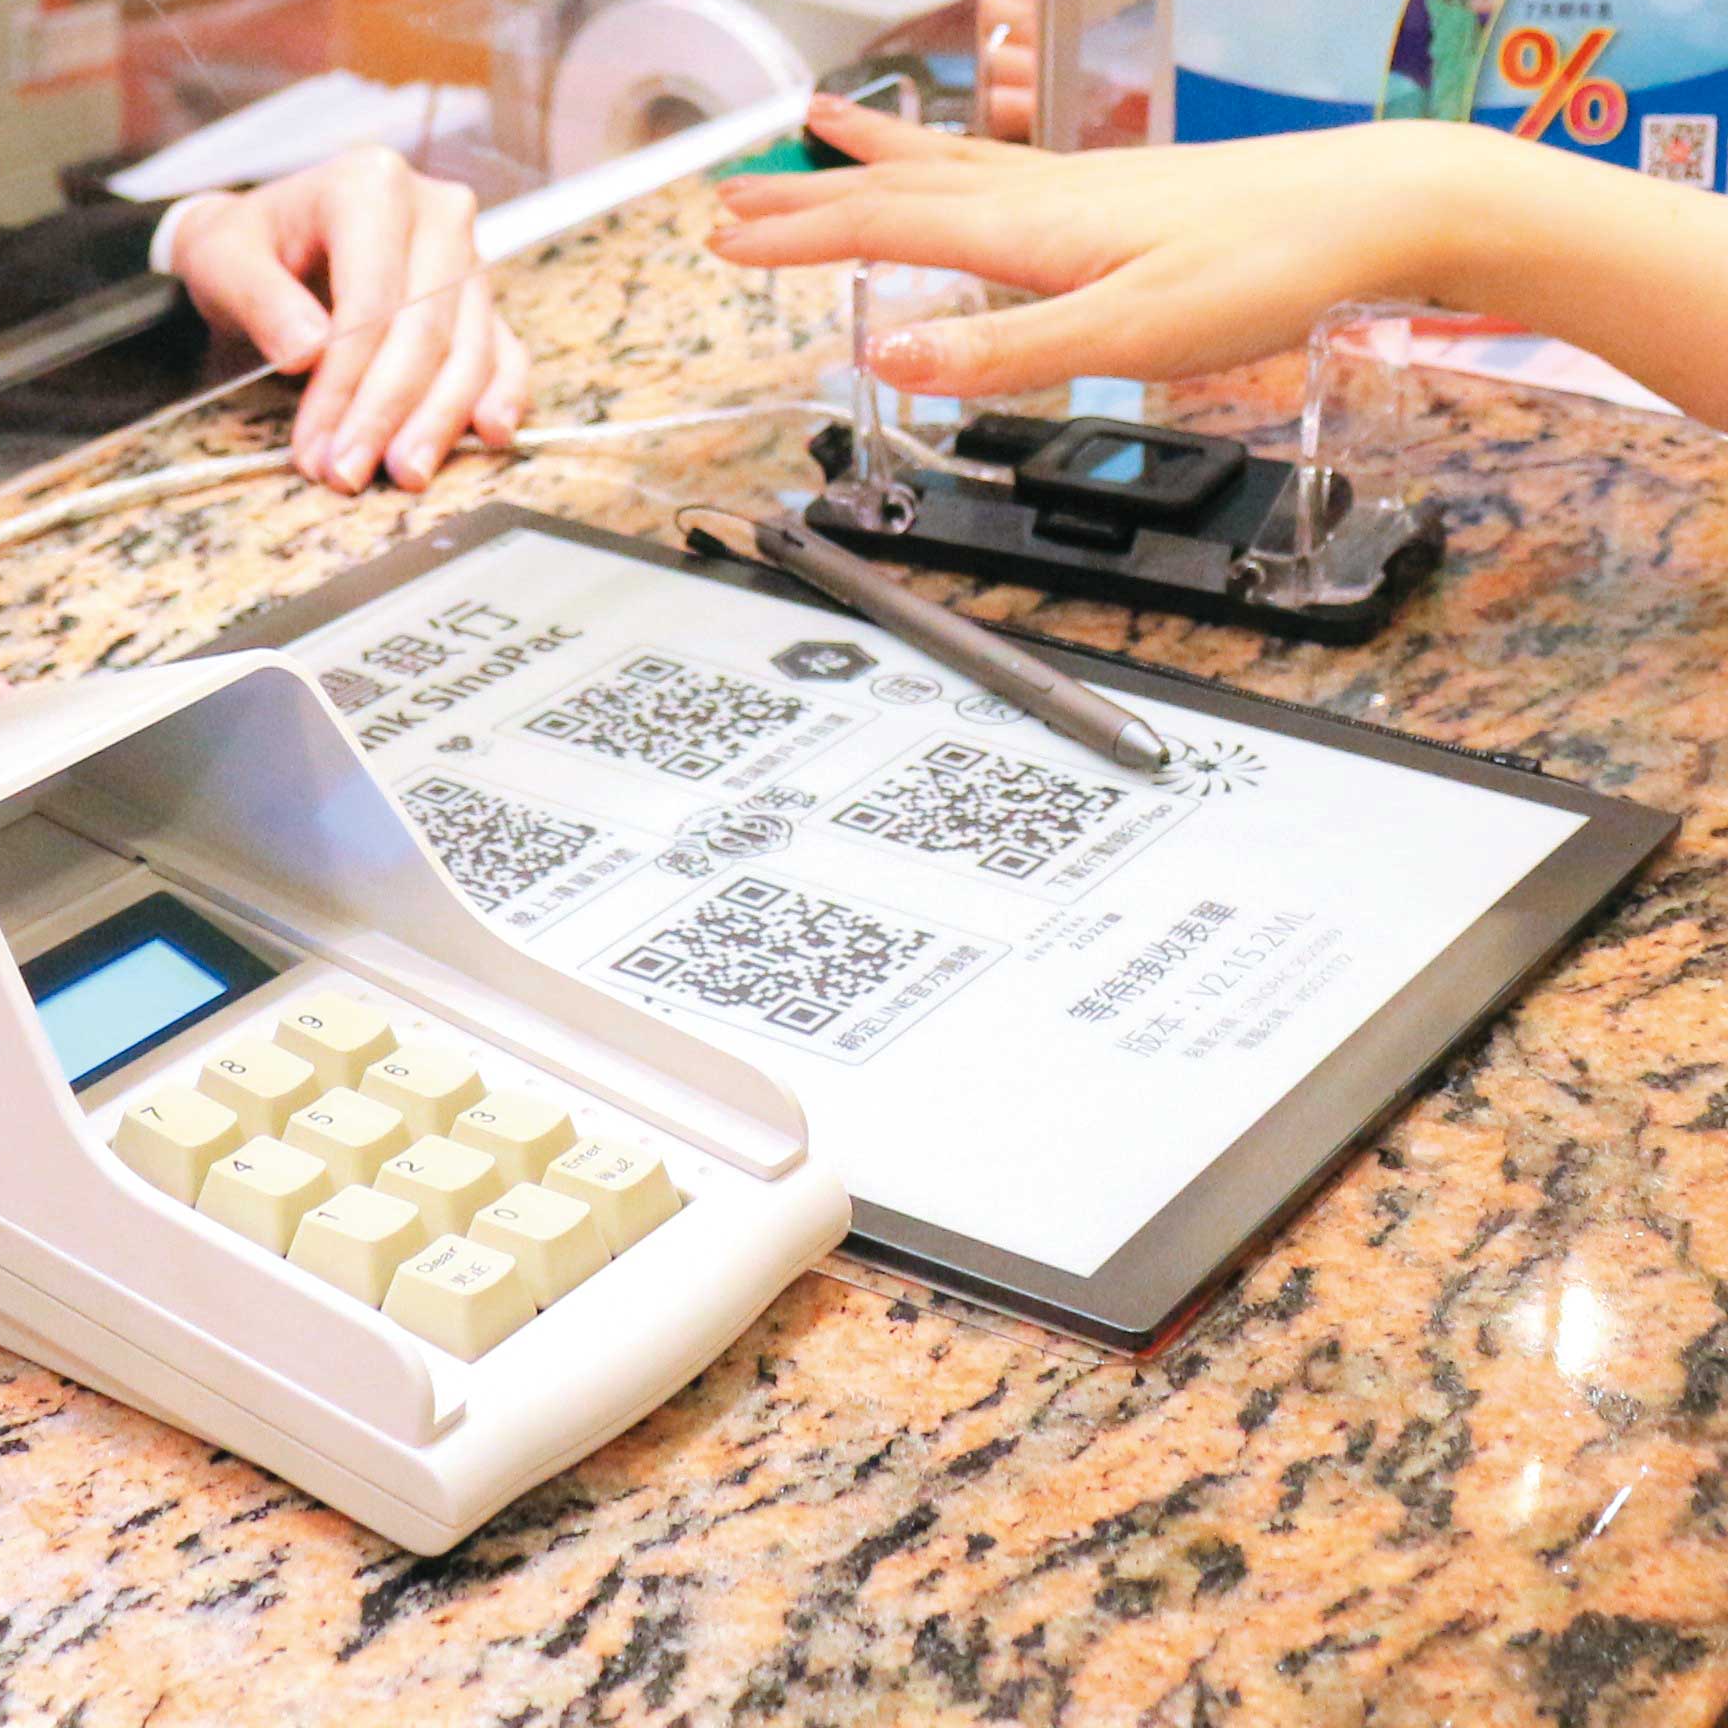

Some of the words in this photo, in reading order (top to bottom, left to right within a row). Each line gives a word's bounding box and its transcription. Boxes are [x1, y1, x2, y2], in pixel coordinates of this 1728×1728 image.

[318, 601, 519, 715] 豐銀行
[359, 710, 427, 752] nk
[411, 625, 583, 711] SinoPac
[1067, 900, 1239, 1022] 等待接收表單
[298, 1014, 323, 1029] 9
[219, 1059, 246, 1074] 8
[384, 1064, 409, 1078] 6
[140, 1106, 163, 1122] 7
[308, 1110, 334, 1125] 5
[469, 1110, 496, 1123] 3
[233, 1159, 254, 1172] 4
[561, 1144, 602, 1172] Enter
[396, 1160, 424, 1173] 2
[318, 1210, 339, 1221] 1
[493, 1207, 519, 1221] 0
[416, 1245, 458, 1275] Clear
